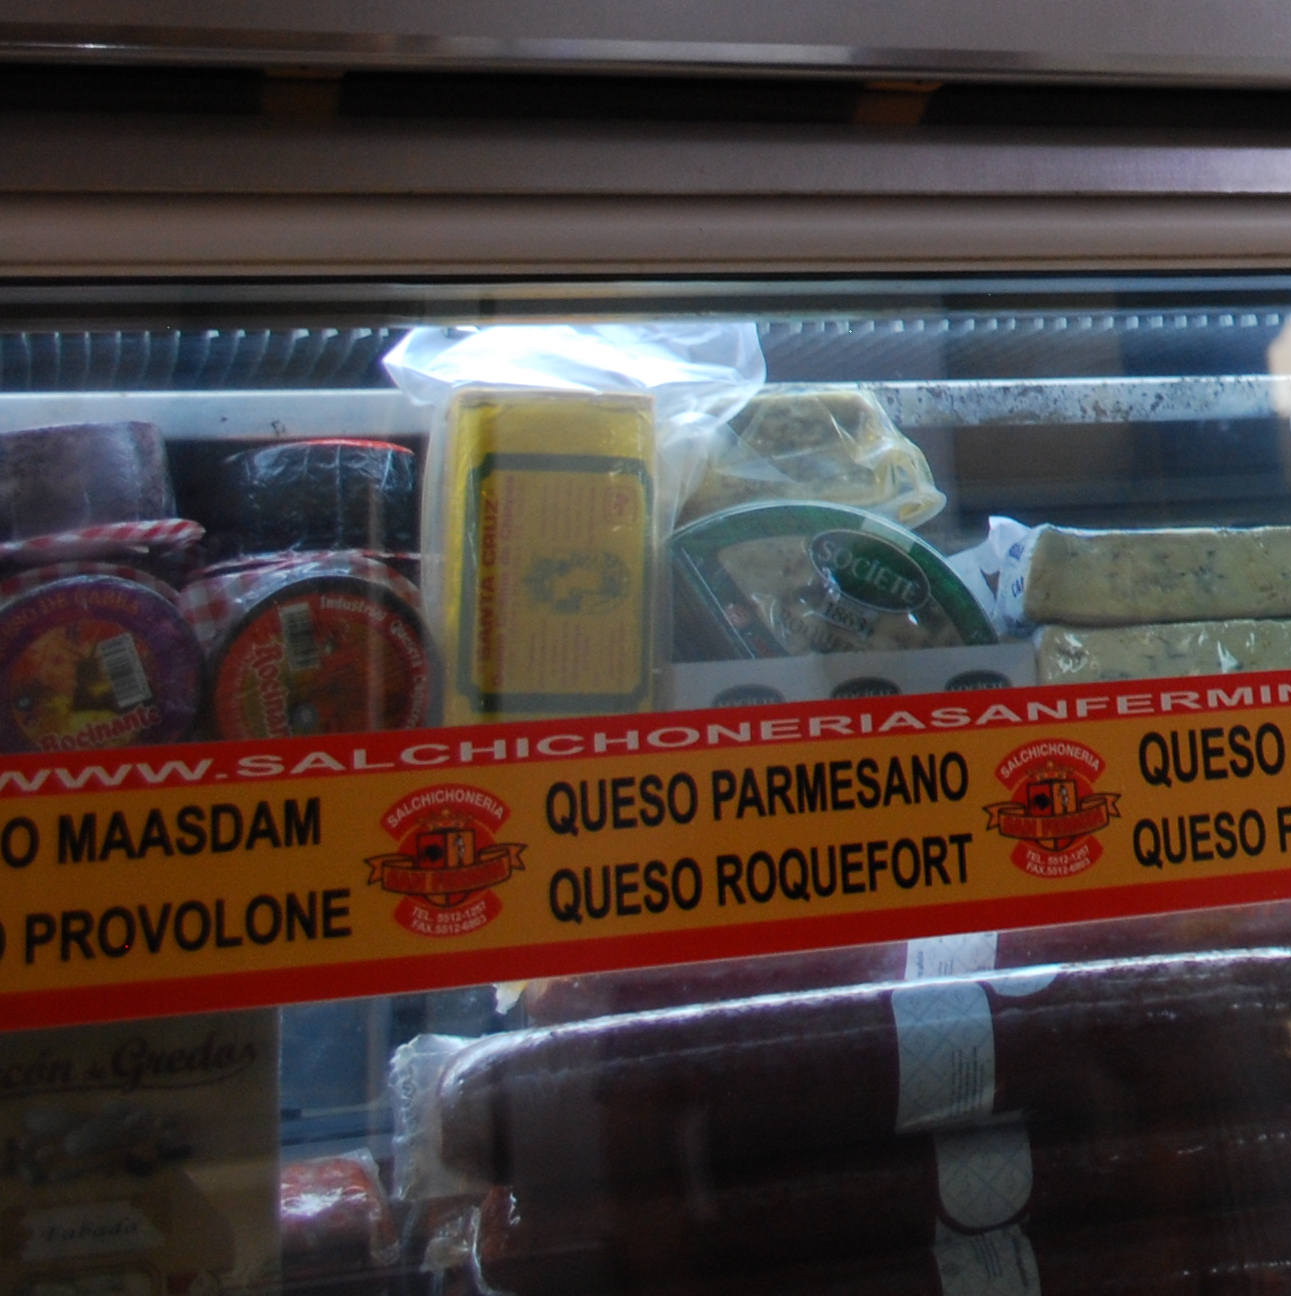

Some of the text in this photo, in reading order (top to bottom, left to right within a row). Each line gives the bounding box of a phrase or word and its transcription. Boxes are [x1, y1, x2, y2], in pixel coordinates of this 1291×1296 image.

[39, 705, 163, 752] Rocinante
[1000, 742, 1100, 780] SALCHICHONERIA
[1138, 721, 1286, 789] QUESO
[387, 789, 505, 829] SALCHICHONERIA
[545, 750, 969, 837] QUESO PARMESANO
[57, 797, 322, 865] MAASDAM
[1132, 810, 1266, 870] QUESO
[548, 832, 973, 925] QUESO ROQUEFORT
[24, 888, 352, 966] PROVOLONE
[110, 1030, 257, 1094] Gredos
